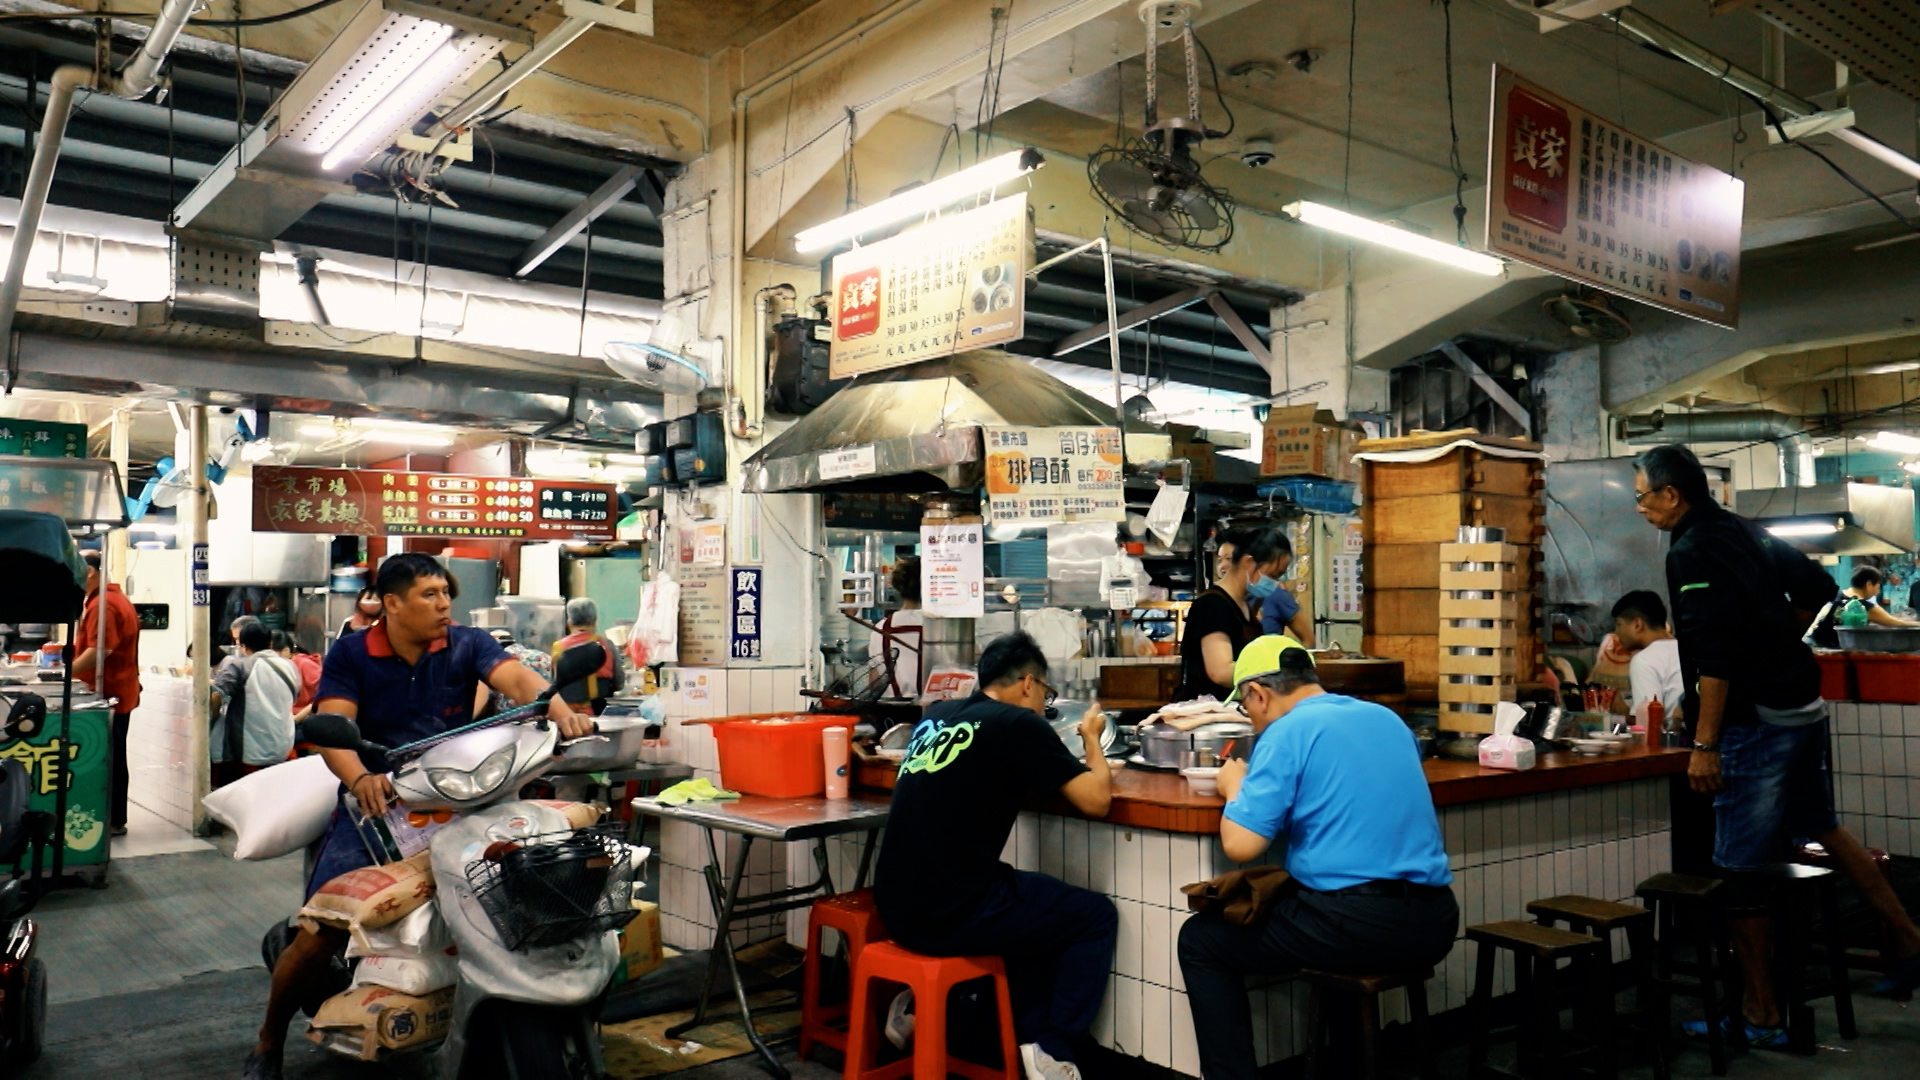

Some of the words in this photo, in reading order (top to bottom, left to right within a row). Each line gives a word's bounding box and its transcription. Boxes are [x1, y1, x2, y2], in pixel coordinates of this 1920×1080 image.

[1058, 431, 1122, 456] 筒仔米糕
[1007, 457, 1071, 484] 排骨酥
[282, 476, 348, 498] 東市場
[736, 571, 758, 635] 飲食區
[734, 639, 761, 657] 16號
